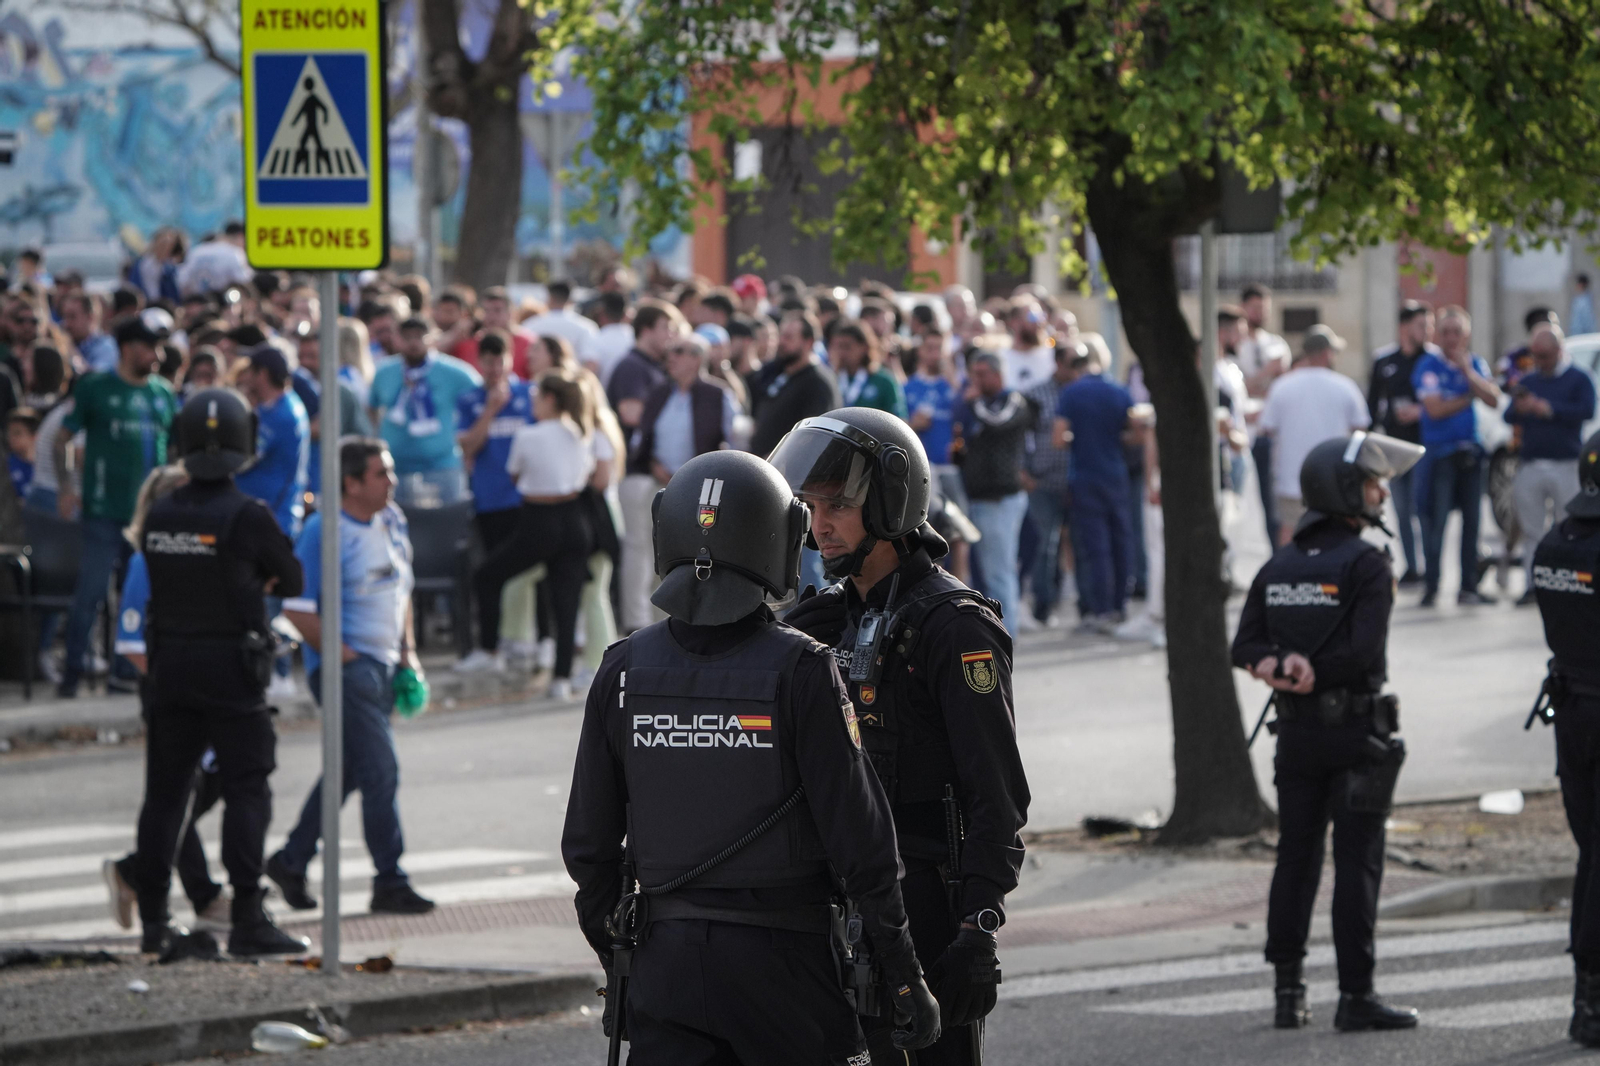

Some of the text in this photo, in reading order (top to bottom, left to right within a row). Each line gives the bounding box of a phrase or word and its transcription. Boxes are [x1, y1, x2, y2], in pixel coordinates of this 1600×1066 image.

[254, 5, 366, 29] ATENCIÓN
[257, 227, 370, 248] PEATONES
[633, 732, 773, 748] NACIONAL
